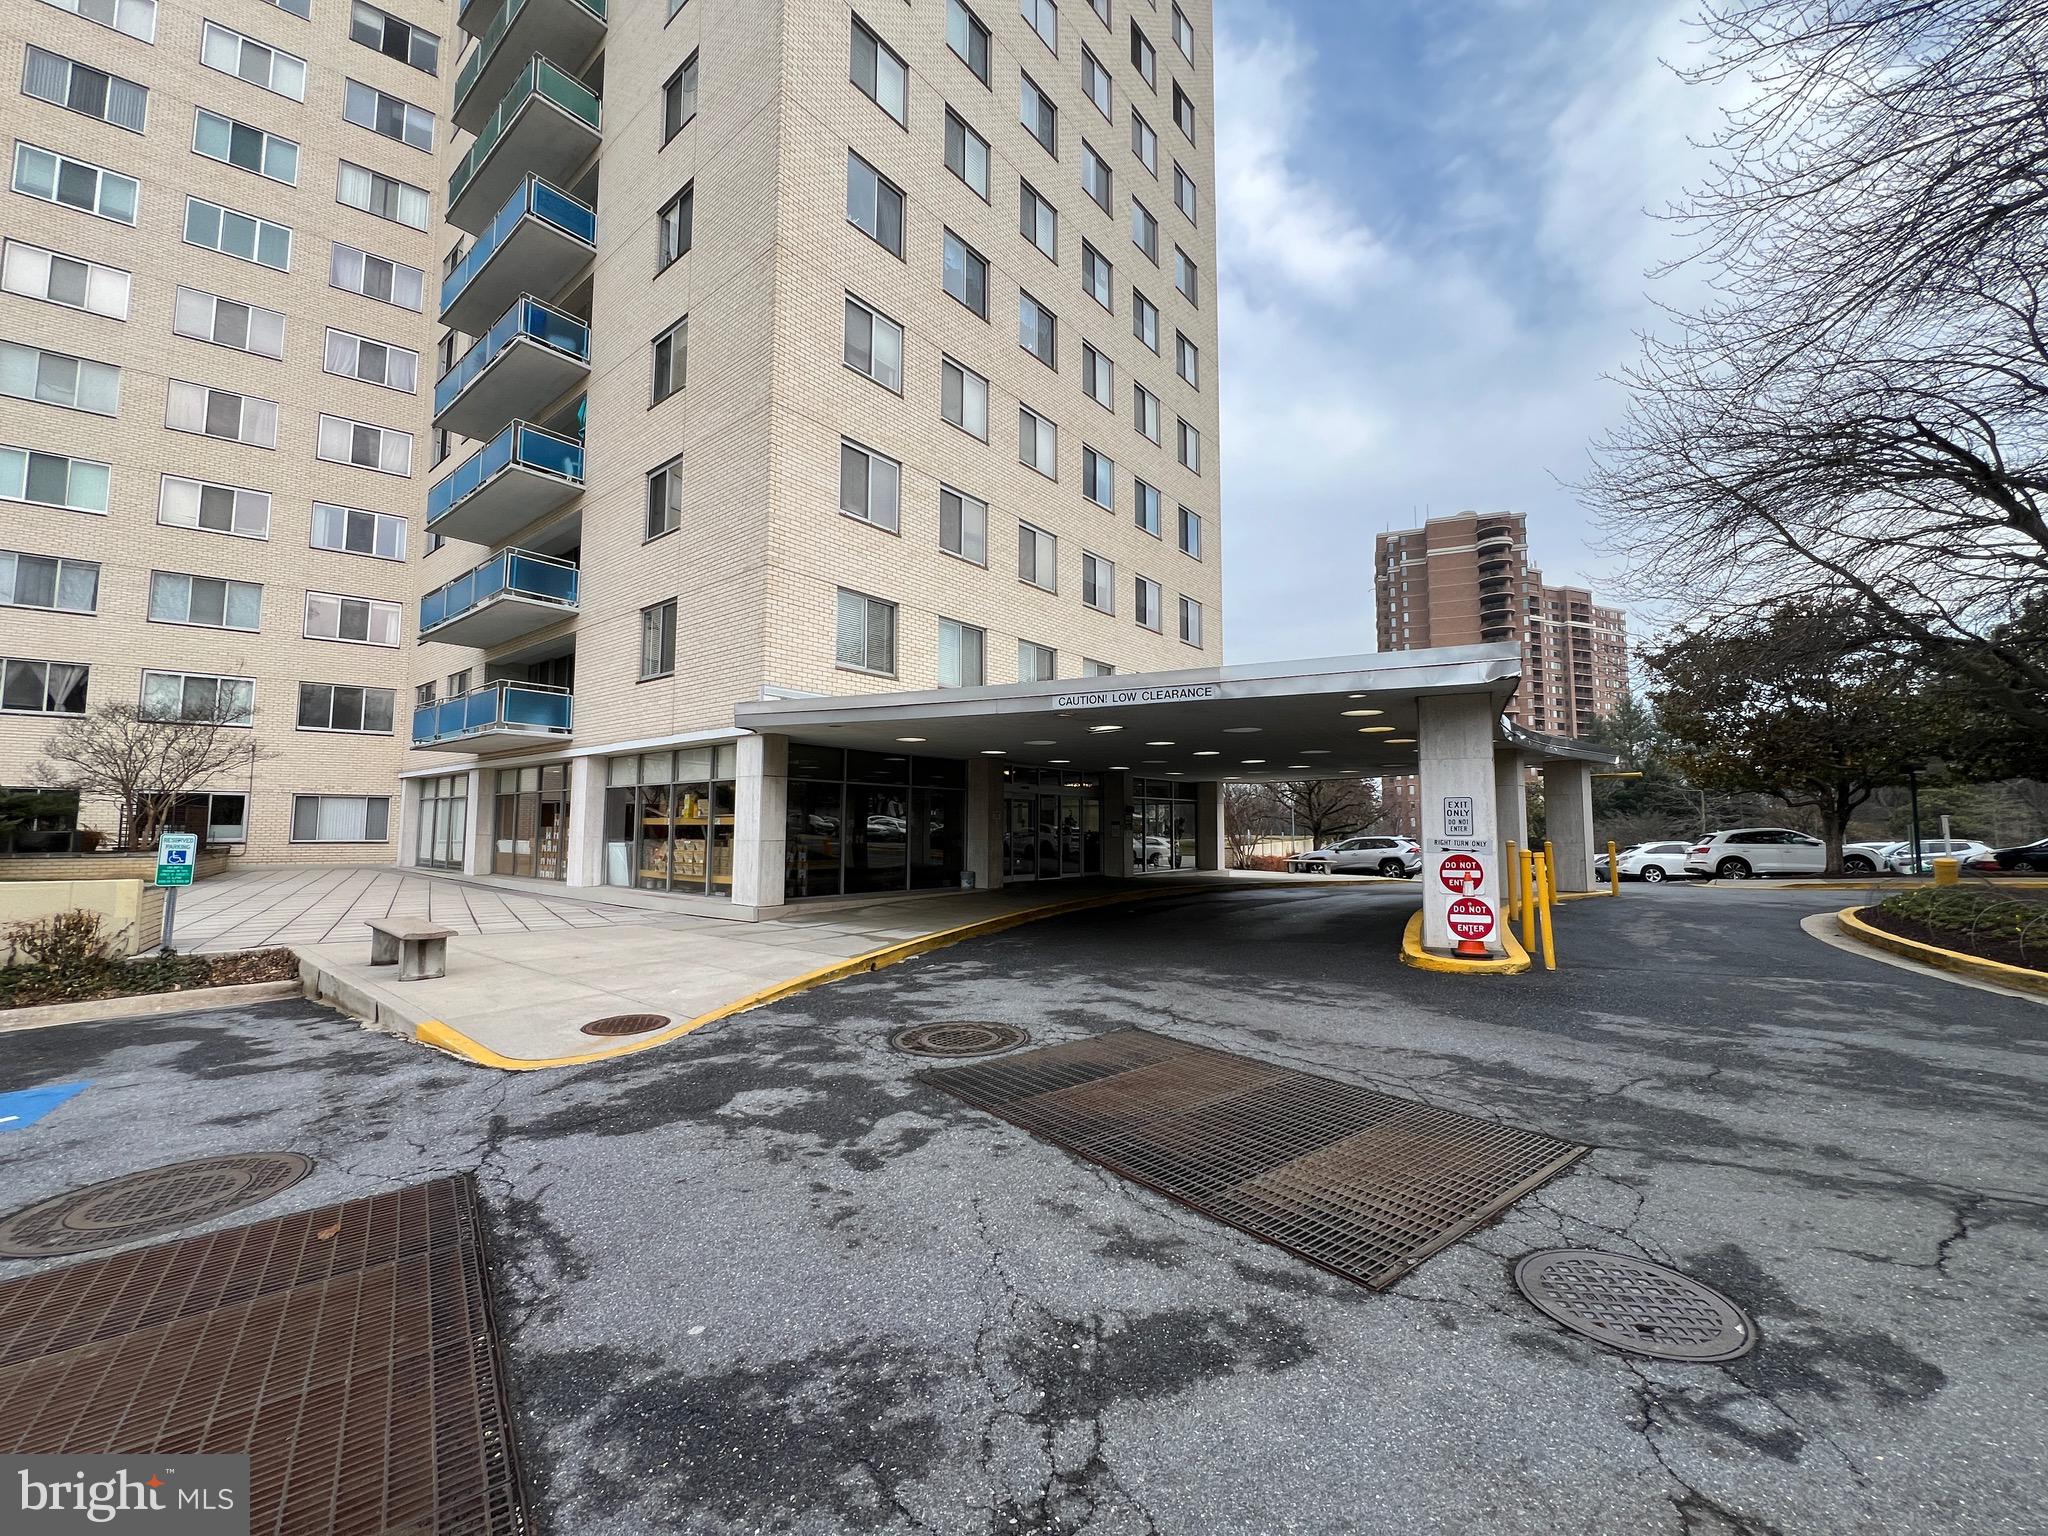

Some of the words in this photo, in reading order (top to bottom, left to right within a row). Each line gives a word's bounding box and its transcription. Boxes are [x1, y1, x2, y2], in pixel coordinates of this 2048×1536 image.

[1058, 695, 1107, 706] CAUTION!
[1112, 693, 1137, 702] LOW
[1141, 688, 1212, 700] CLEARANCE
